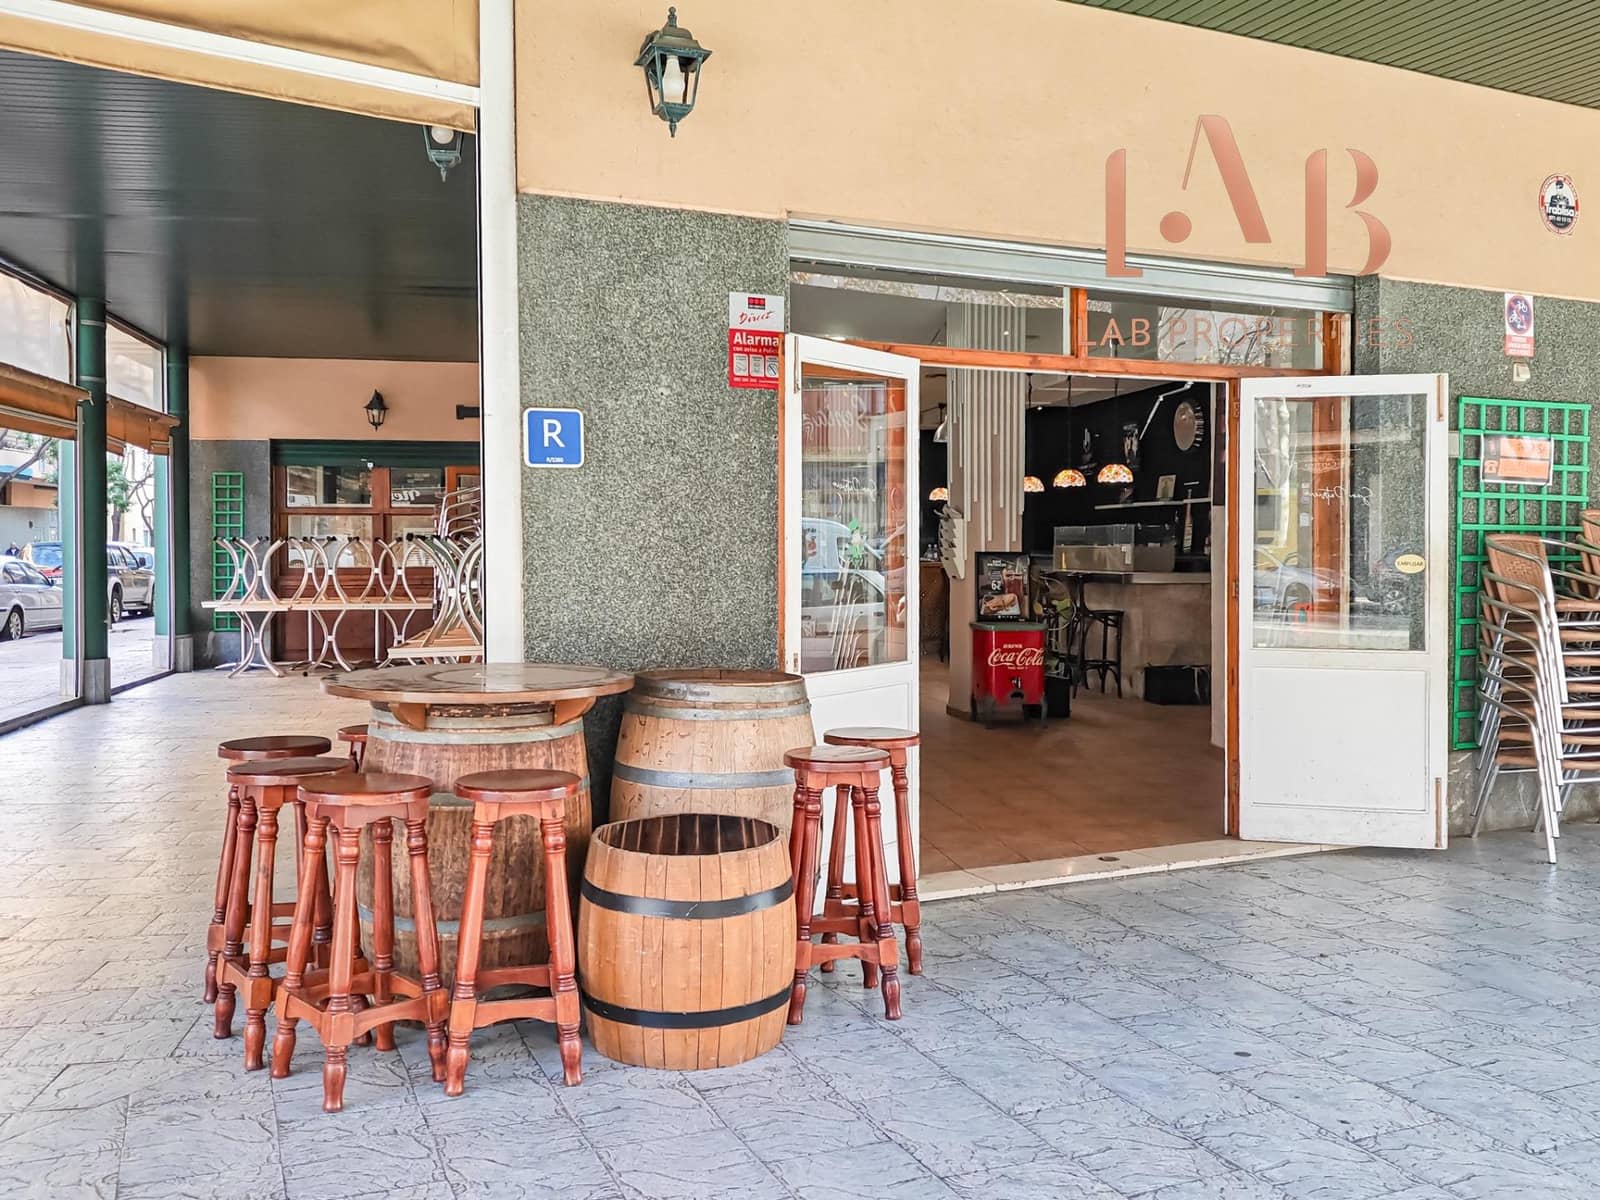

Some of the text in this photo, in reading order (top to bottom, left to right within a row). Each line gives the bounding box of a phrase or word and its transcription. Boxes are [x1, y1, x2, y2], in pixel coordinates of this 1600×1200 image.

[733, 332, 779, 346] Alarma
[543, 418, 566, 448] R
[987, 647, 1045, 667] Coca-Cola
